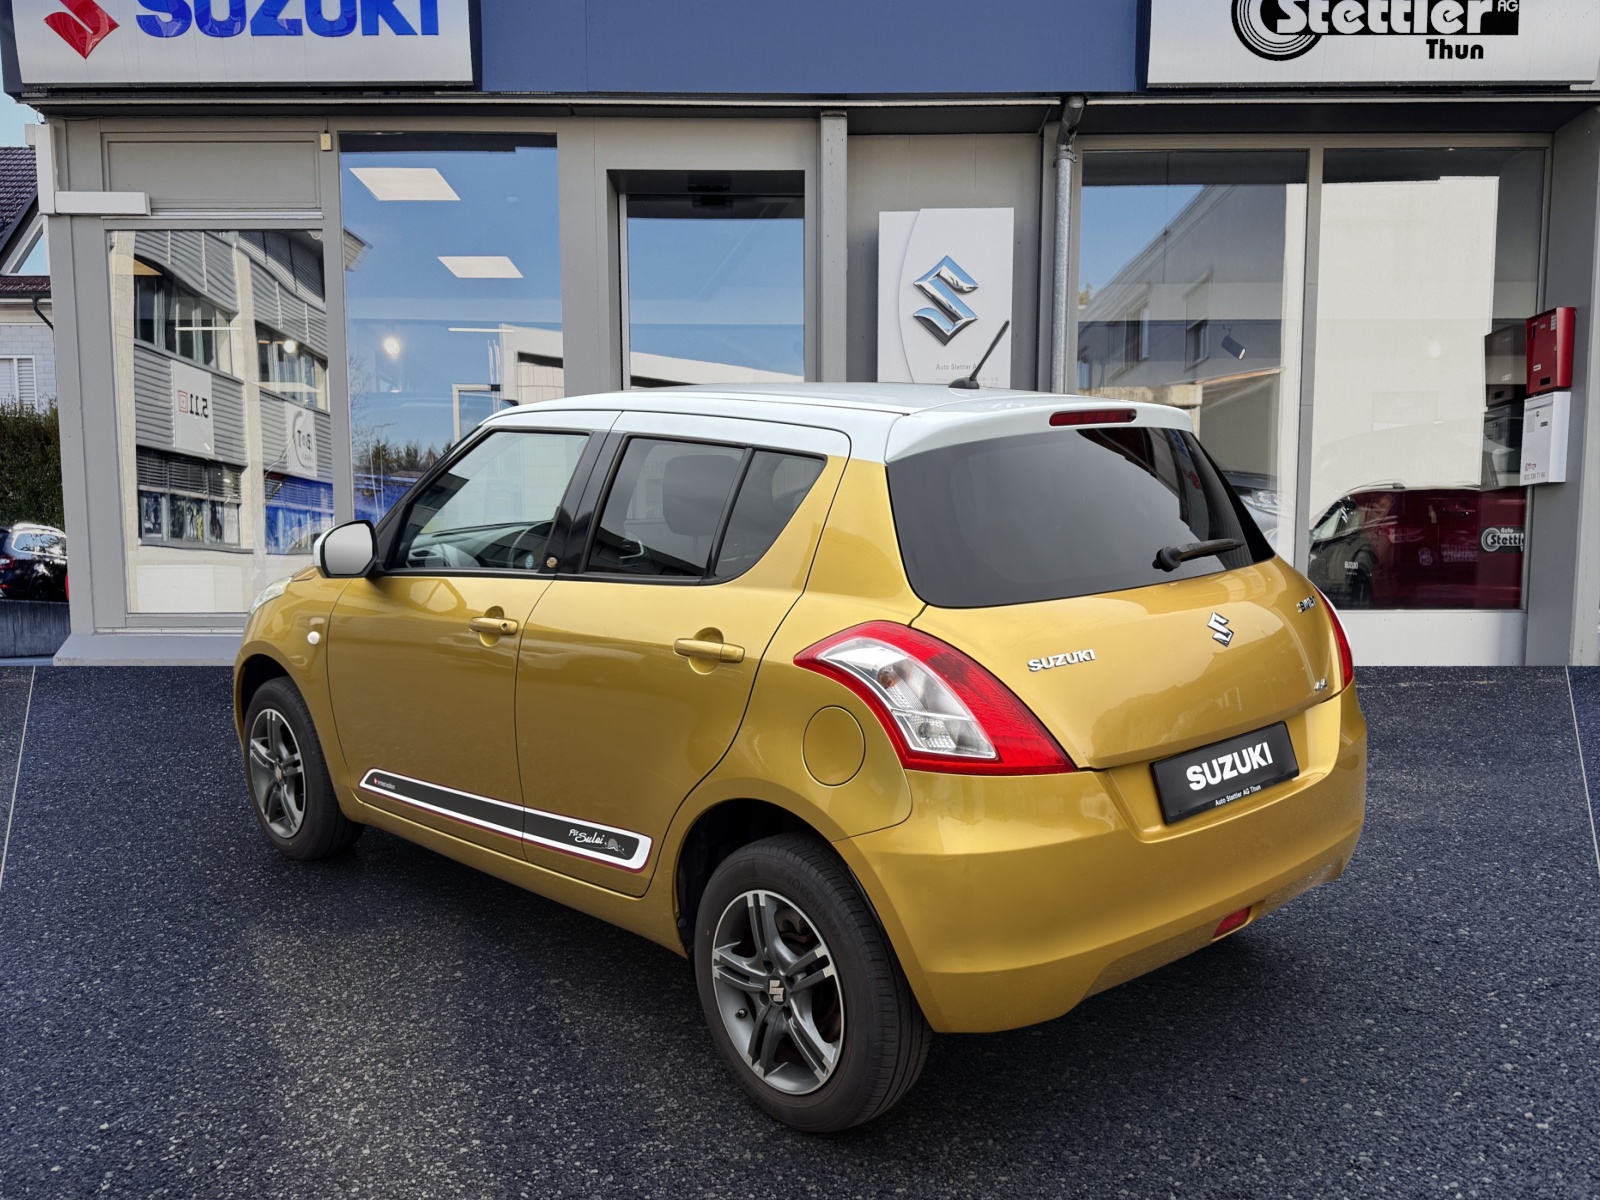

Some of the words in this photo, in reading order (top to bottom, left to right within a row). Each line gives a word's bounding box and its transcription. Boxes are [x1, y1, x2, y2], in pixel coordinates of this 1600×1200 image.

[136, 0, 440, 38] SUZUKI
[1277, 0, 1493, 35] Stettler
[1497, 0, 1519, 13] AG
[1426, 39, 1484, 59] Thun
[936, 363, 950, 371] Auto
[951, 363, 971, 371] Stettler
[1027, 649, 1096, 672] SUZUKI
[1186, 741, 1274, 791] SUZUKI
[1226, 791, 1243, 802] Stettler
[1243, 787, 1250, 796] AG
[1250, 784, 1262, 793] Thun
[787, 873, 841, 942] YOKOHAMA
